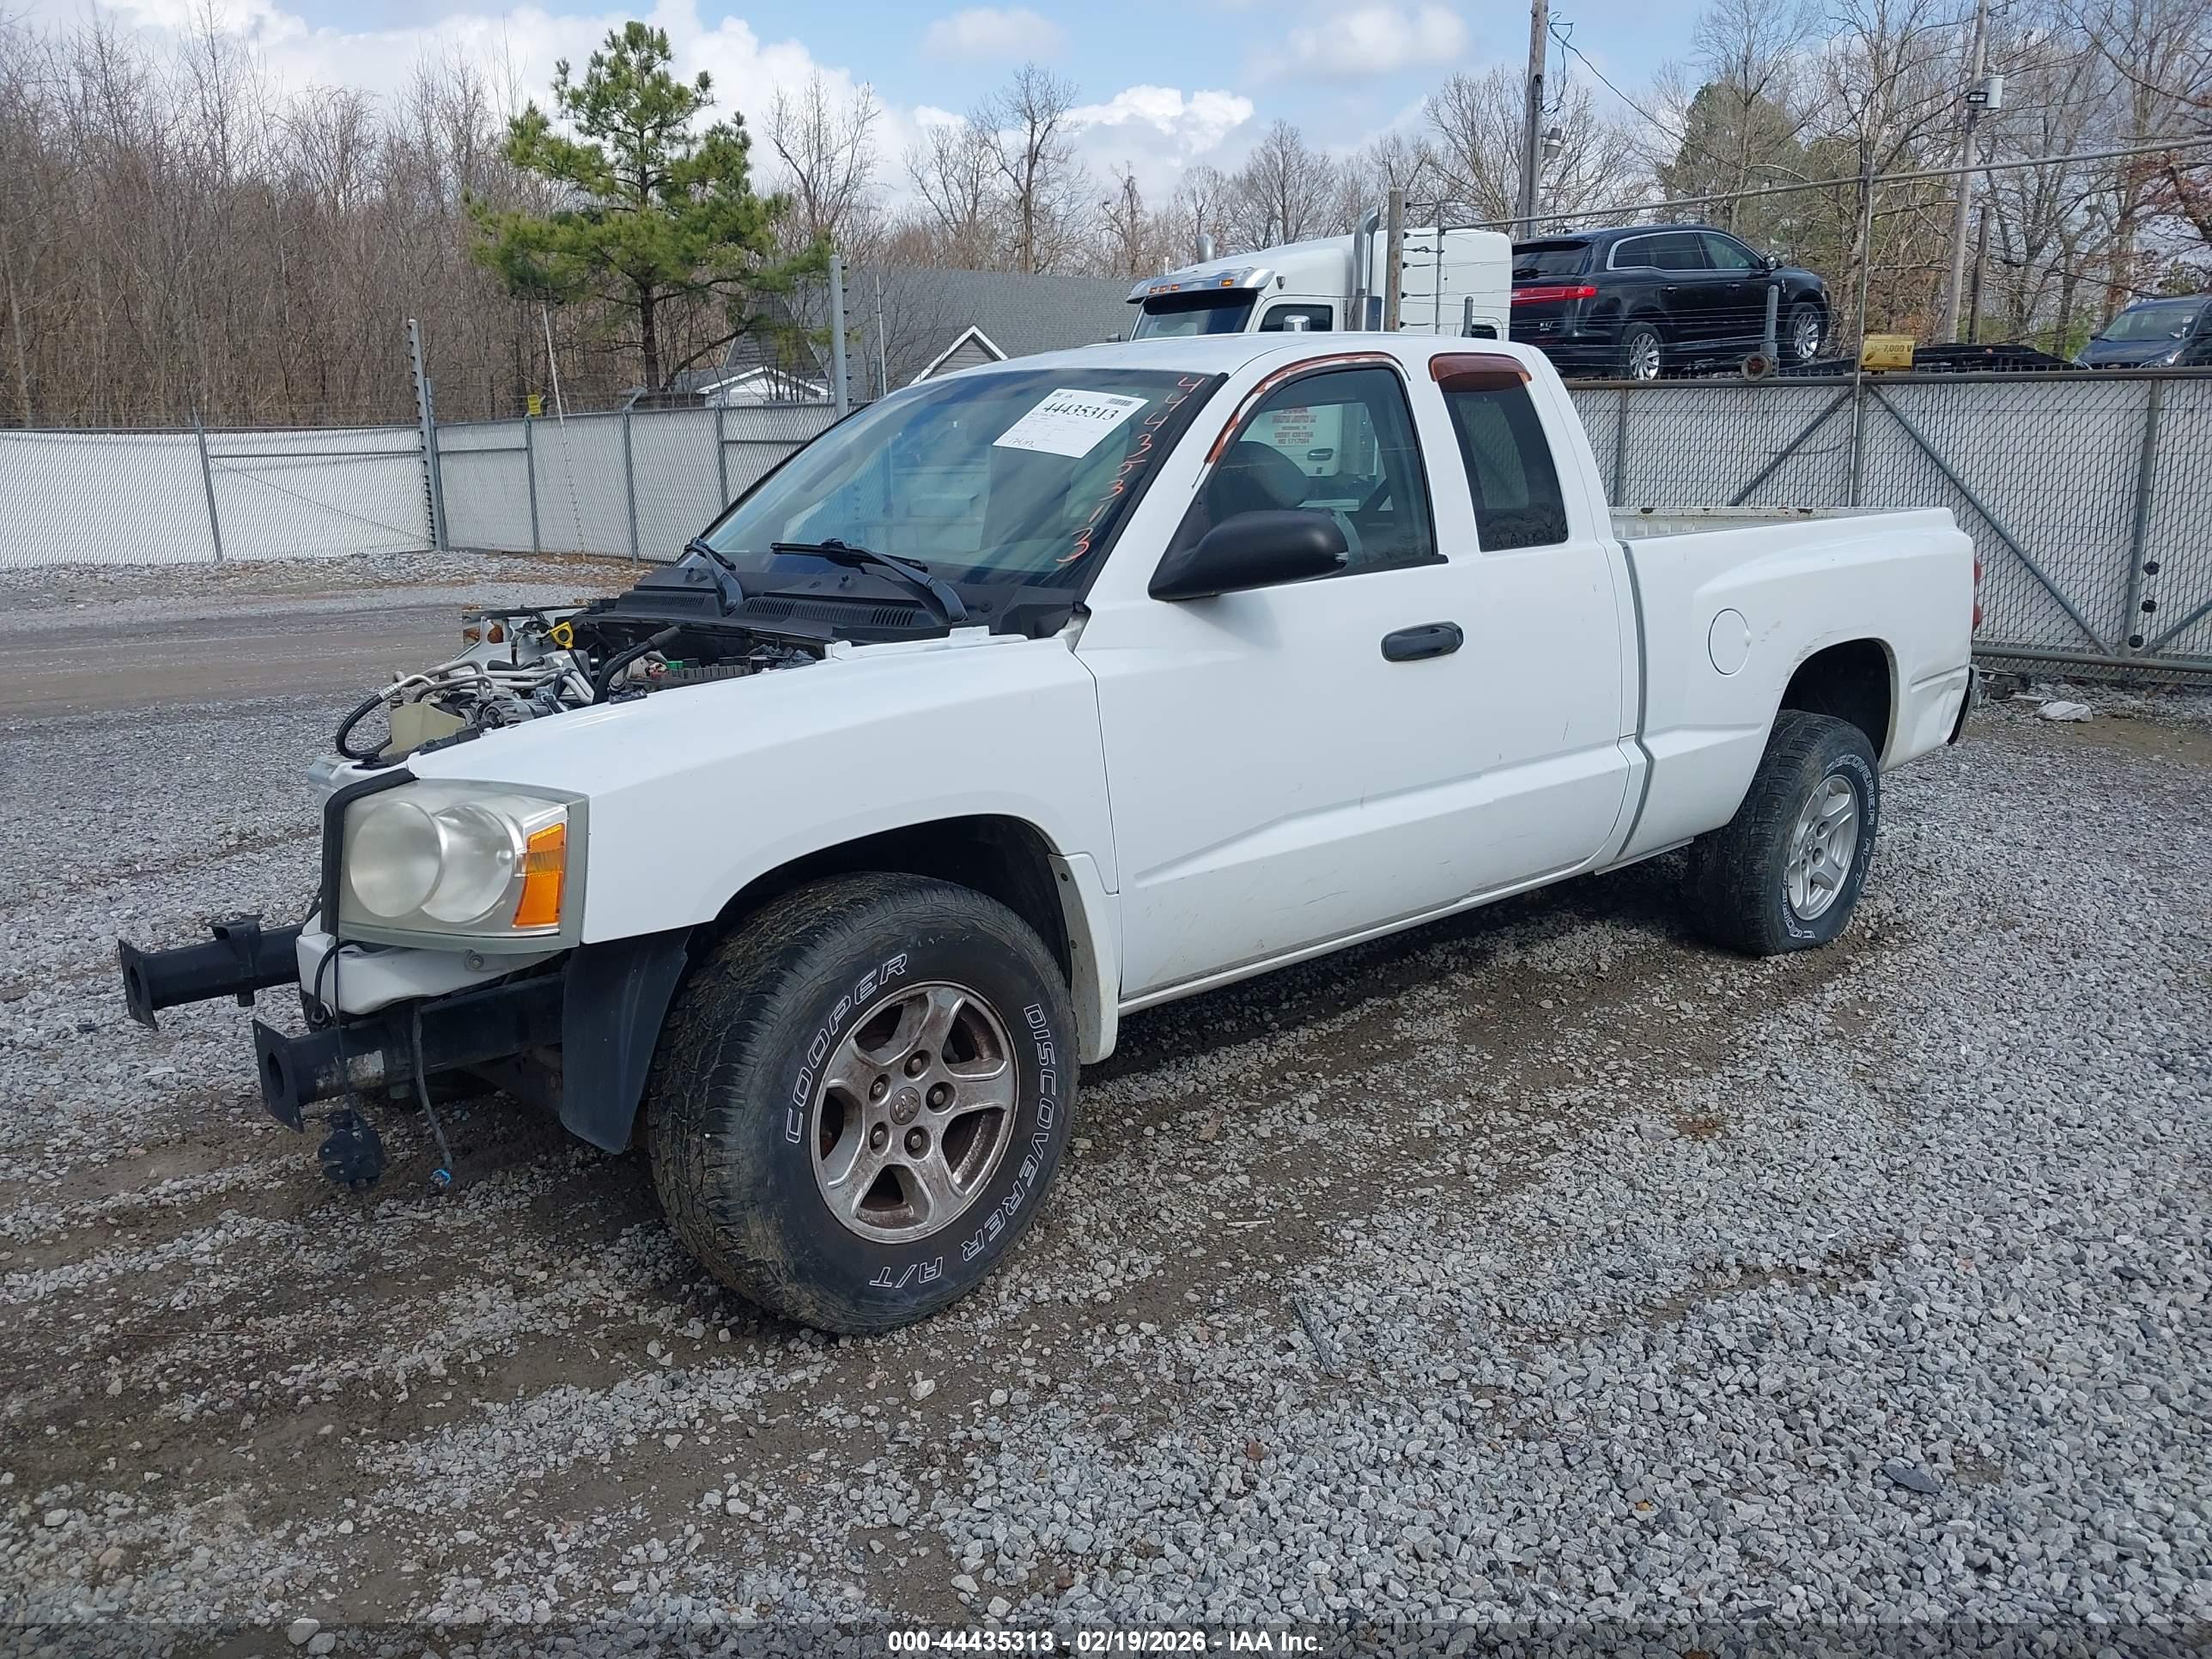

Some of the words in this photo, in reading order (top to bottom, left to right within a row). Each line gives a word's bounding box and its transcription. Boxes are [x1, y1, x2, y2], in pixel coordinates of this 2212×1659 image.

[1883, 344, 1905, 355] 7,000
[1042, 401, 1119, 420] 44435313
[1823, 754, 1875, 826] DISCOVERER
[786, 953, 908, 1144] COOPER
[961, 1003, 1056, 1262] DISCOVERER
[868, 1256, 943, 1288] A/T
